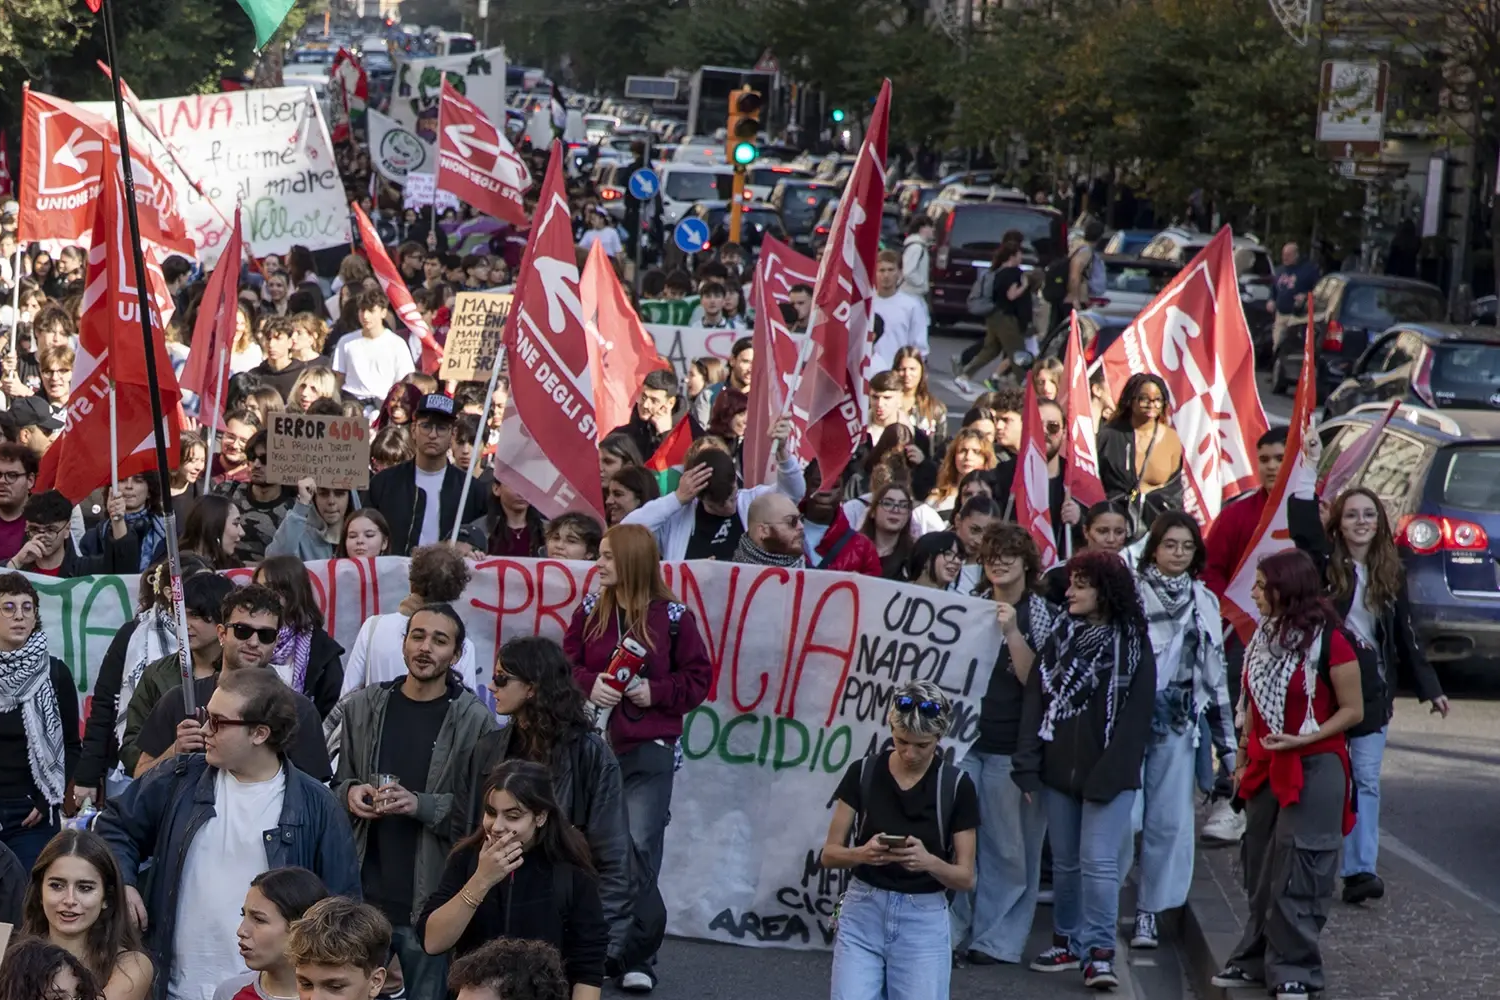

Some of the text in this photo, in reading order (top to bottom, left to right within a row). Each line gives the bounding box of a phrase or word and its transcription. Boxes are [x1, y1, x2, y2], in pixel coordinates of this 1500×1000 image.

[534, 361, 582, 420] DEGLI
[274, 416, 365, 442] ERROR 404
[883, 591, 968, 645] UDS
[855, 633, 979, 697] NAPOLI
[682, 704, 852, 775] OCIDIO
